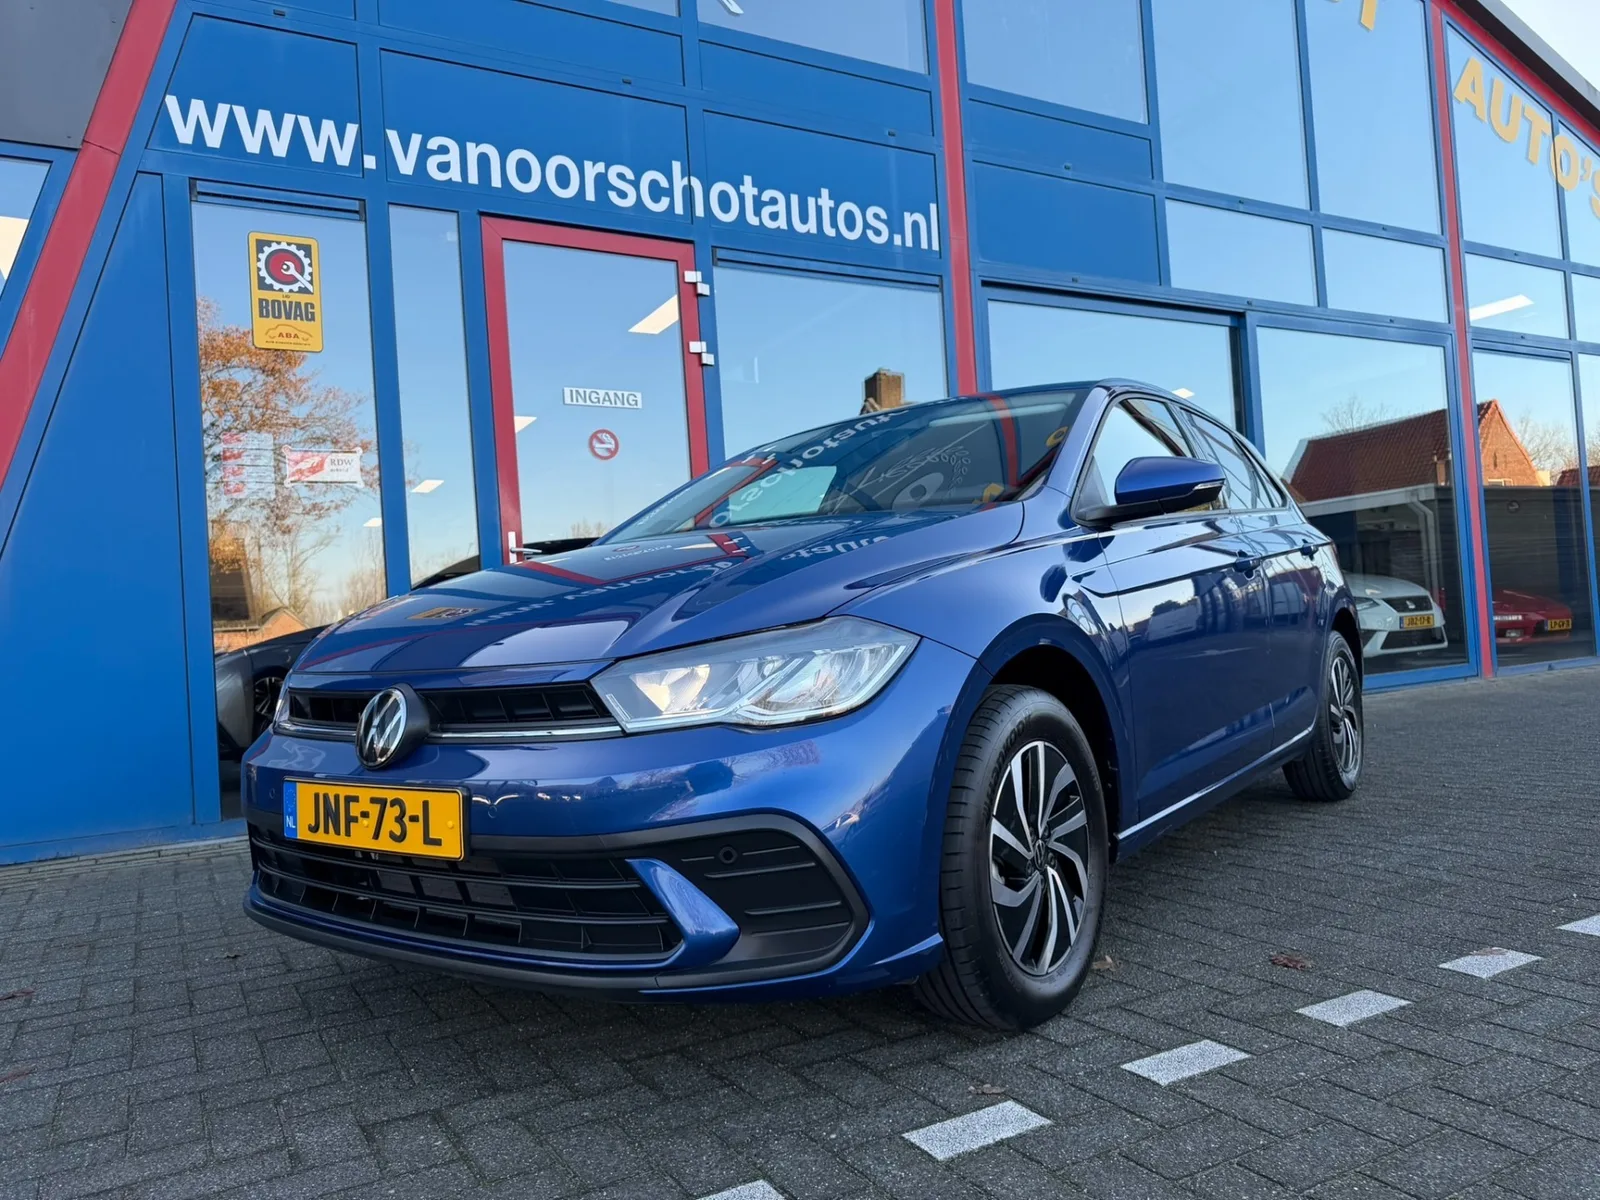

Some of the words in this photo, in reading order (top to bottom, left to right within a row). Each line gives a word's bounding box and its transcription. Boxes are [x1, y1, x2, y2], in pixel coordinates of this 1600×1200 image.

[165, 94, 939, 251] www.vanoorschotautos.nl
[258, 297, 316, 322] BOVAG
[277, 332, 300, 340] ABA
[569, 389, 639, 407] INGANG
[330, 458, 354, 467] RDW
[286, 815, 296, 829] NL
[307, 792, 442, 847] JNF-73-L
